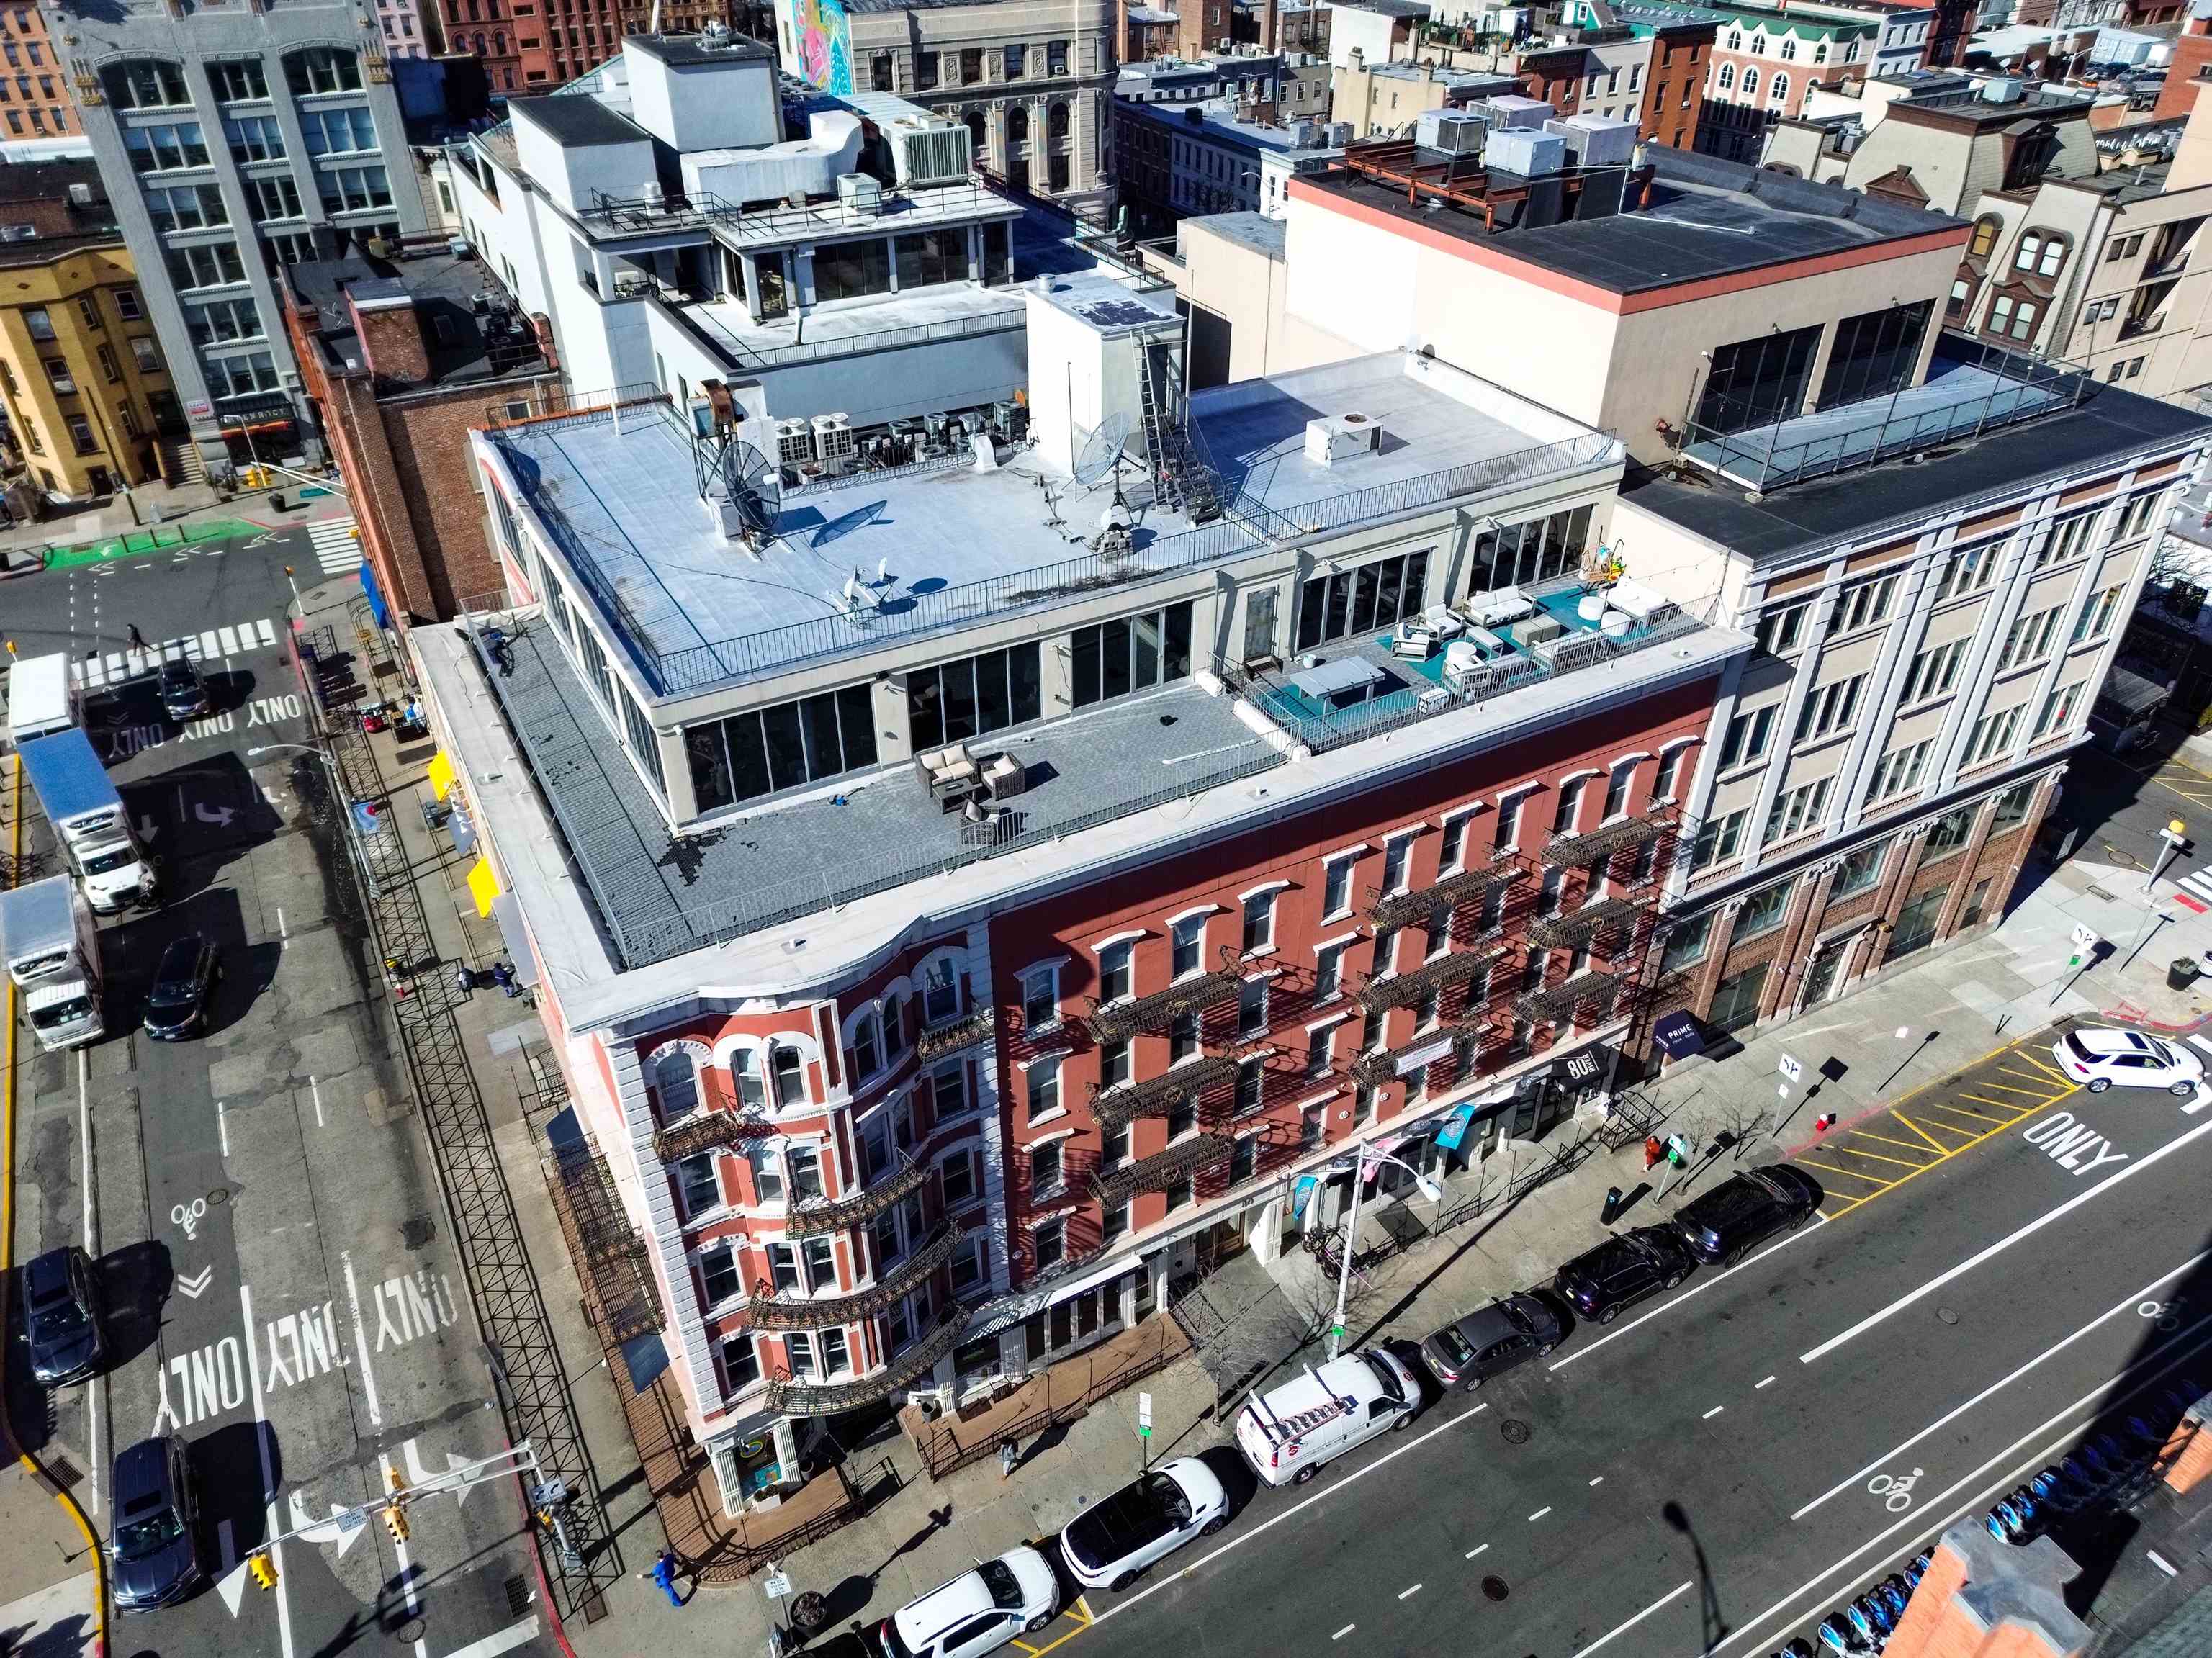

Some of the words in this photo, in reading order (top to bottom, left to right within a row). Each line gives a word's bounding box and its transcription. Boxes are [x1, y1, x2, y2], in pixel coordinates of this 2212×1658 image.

[247, 694, 301, 728] ONLY
[109, 722, 164, 758] ONLY
[1668, 1023, 1692, 1039] PRIME
[1567, 1058, 1589, 1080] 80
[1583, 1053, 1596, 1073] RIVER
[2023, 1112, 2129, 1176] ONLY
[374, 1271, 459, 1352] ONLY
[151, 1335, 245, 1438] ONLY
